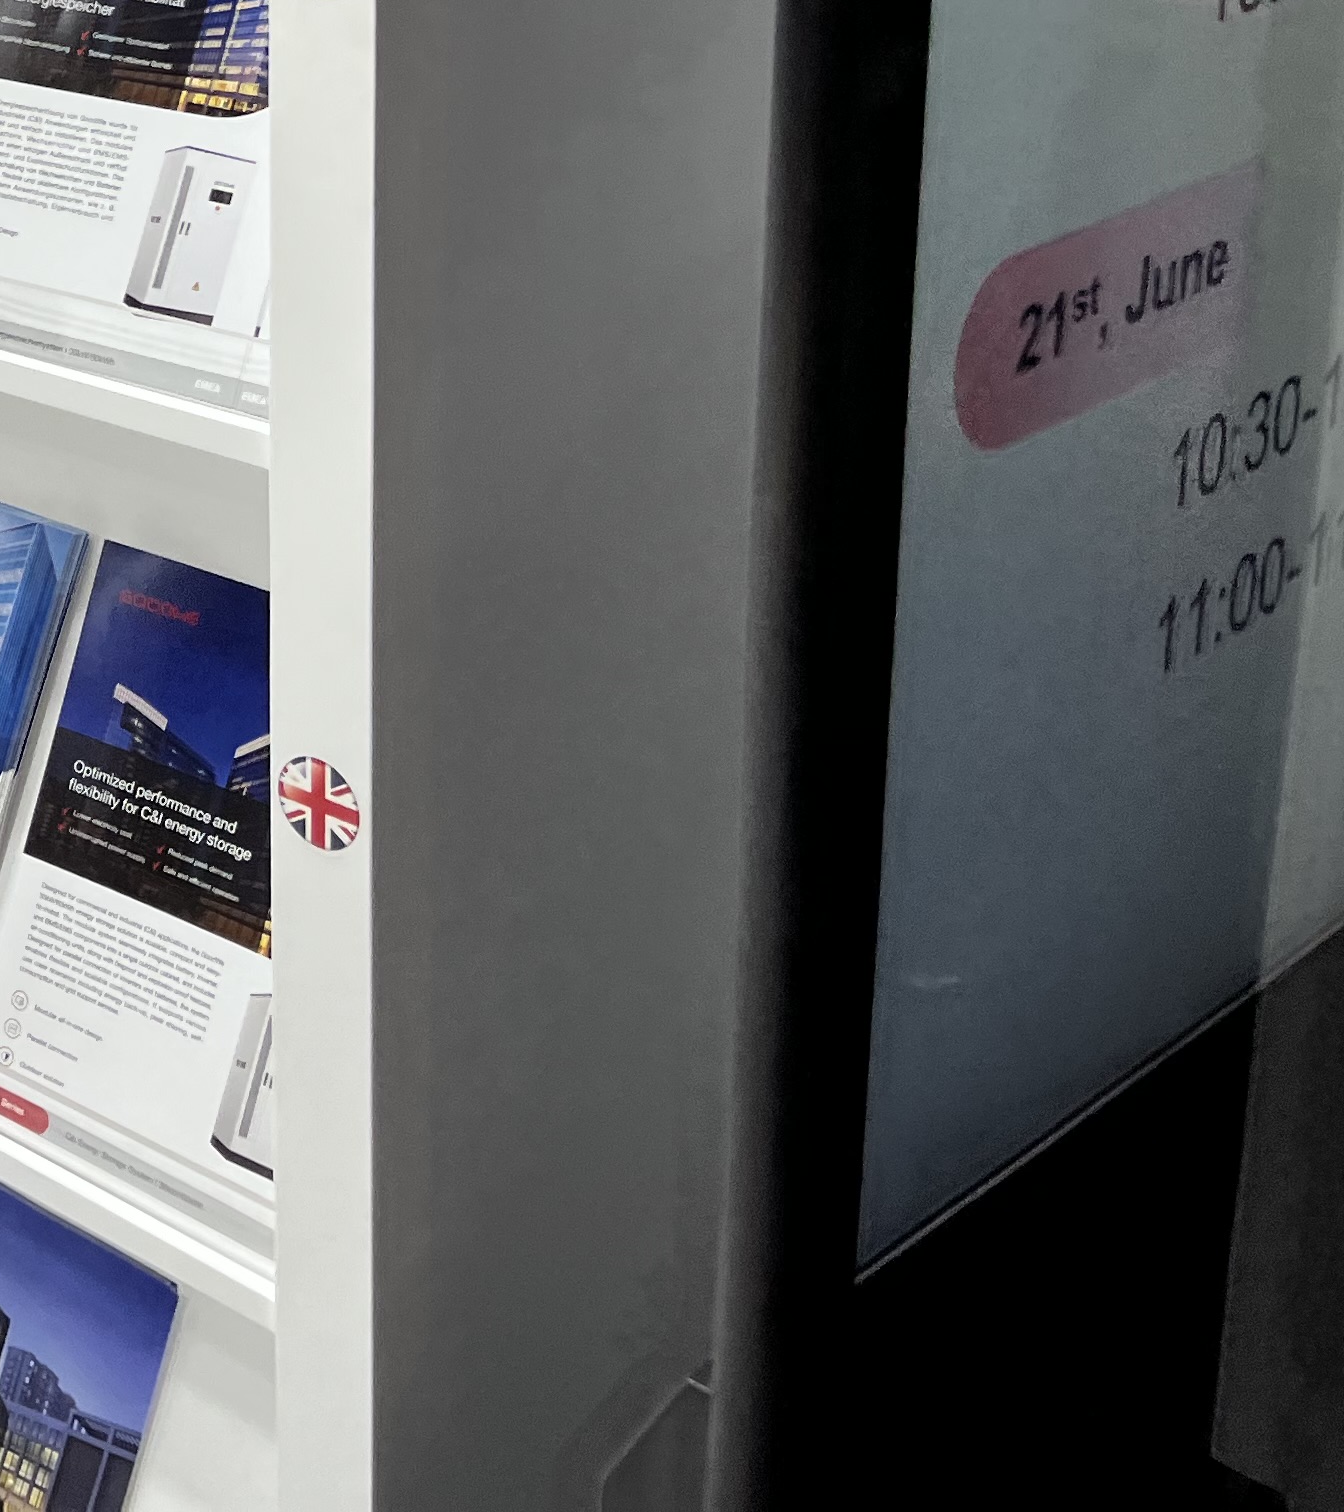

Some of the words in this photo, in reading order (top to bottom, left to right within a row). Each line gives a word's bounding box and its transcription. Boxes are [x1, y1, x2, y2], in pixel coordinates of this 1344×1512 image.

[1125, 241, 1229, 324] June
[68, 777, 121, 810] flexibility
[120, 797, 141, 816] for
[140, 804, 163, 826] C&I
[163, 815, 206, 845] energy
[205, 833, 253, 862] storage
[73, 758, 136, 794] Optimized
[135, 783, 212, 825] performance
[211, 813, 238, 836] and
